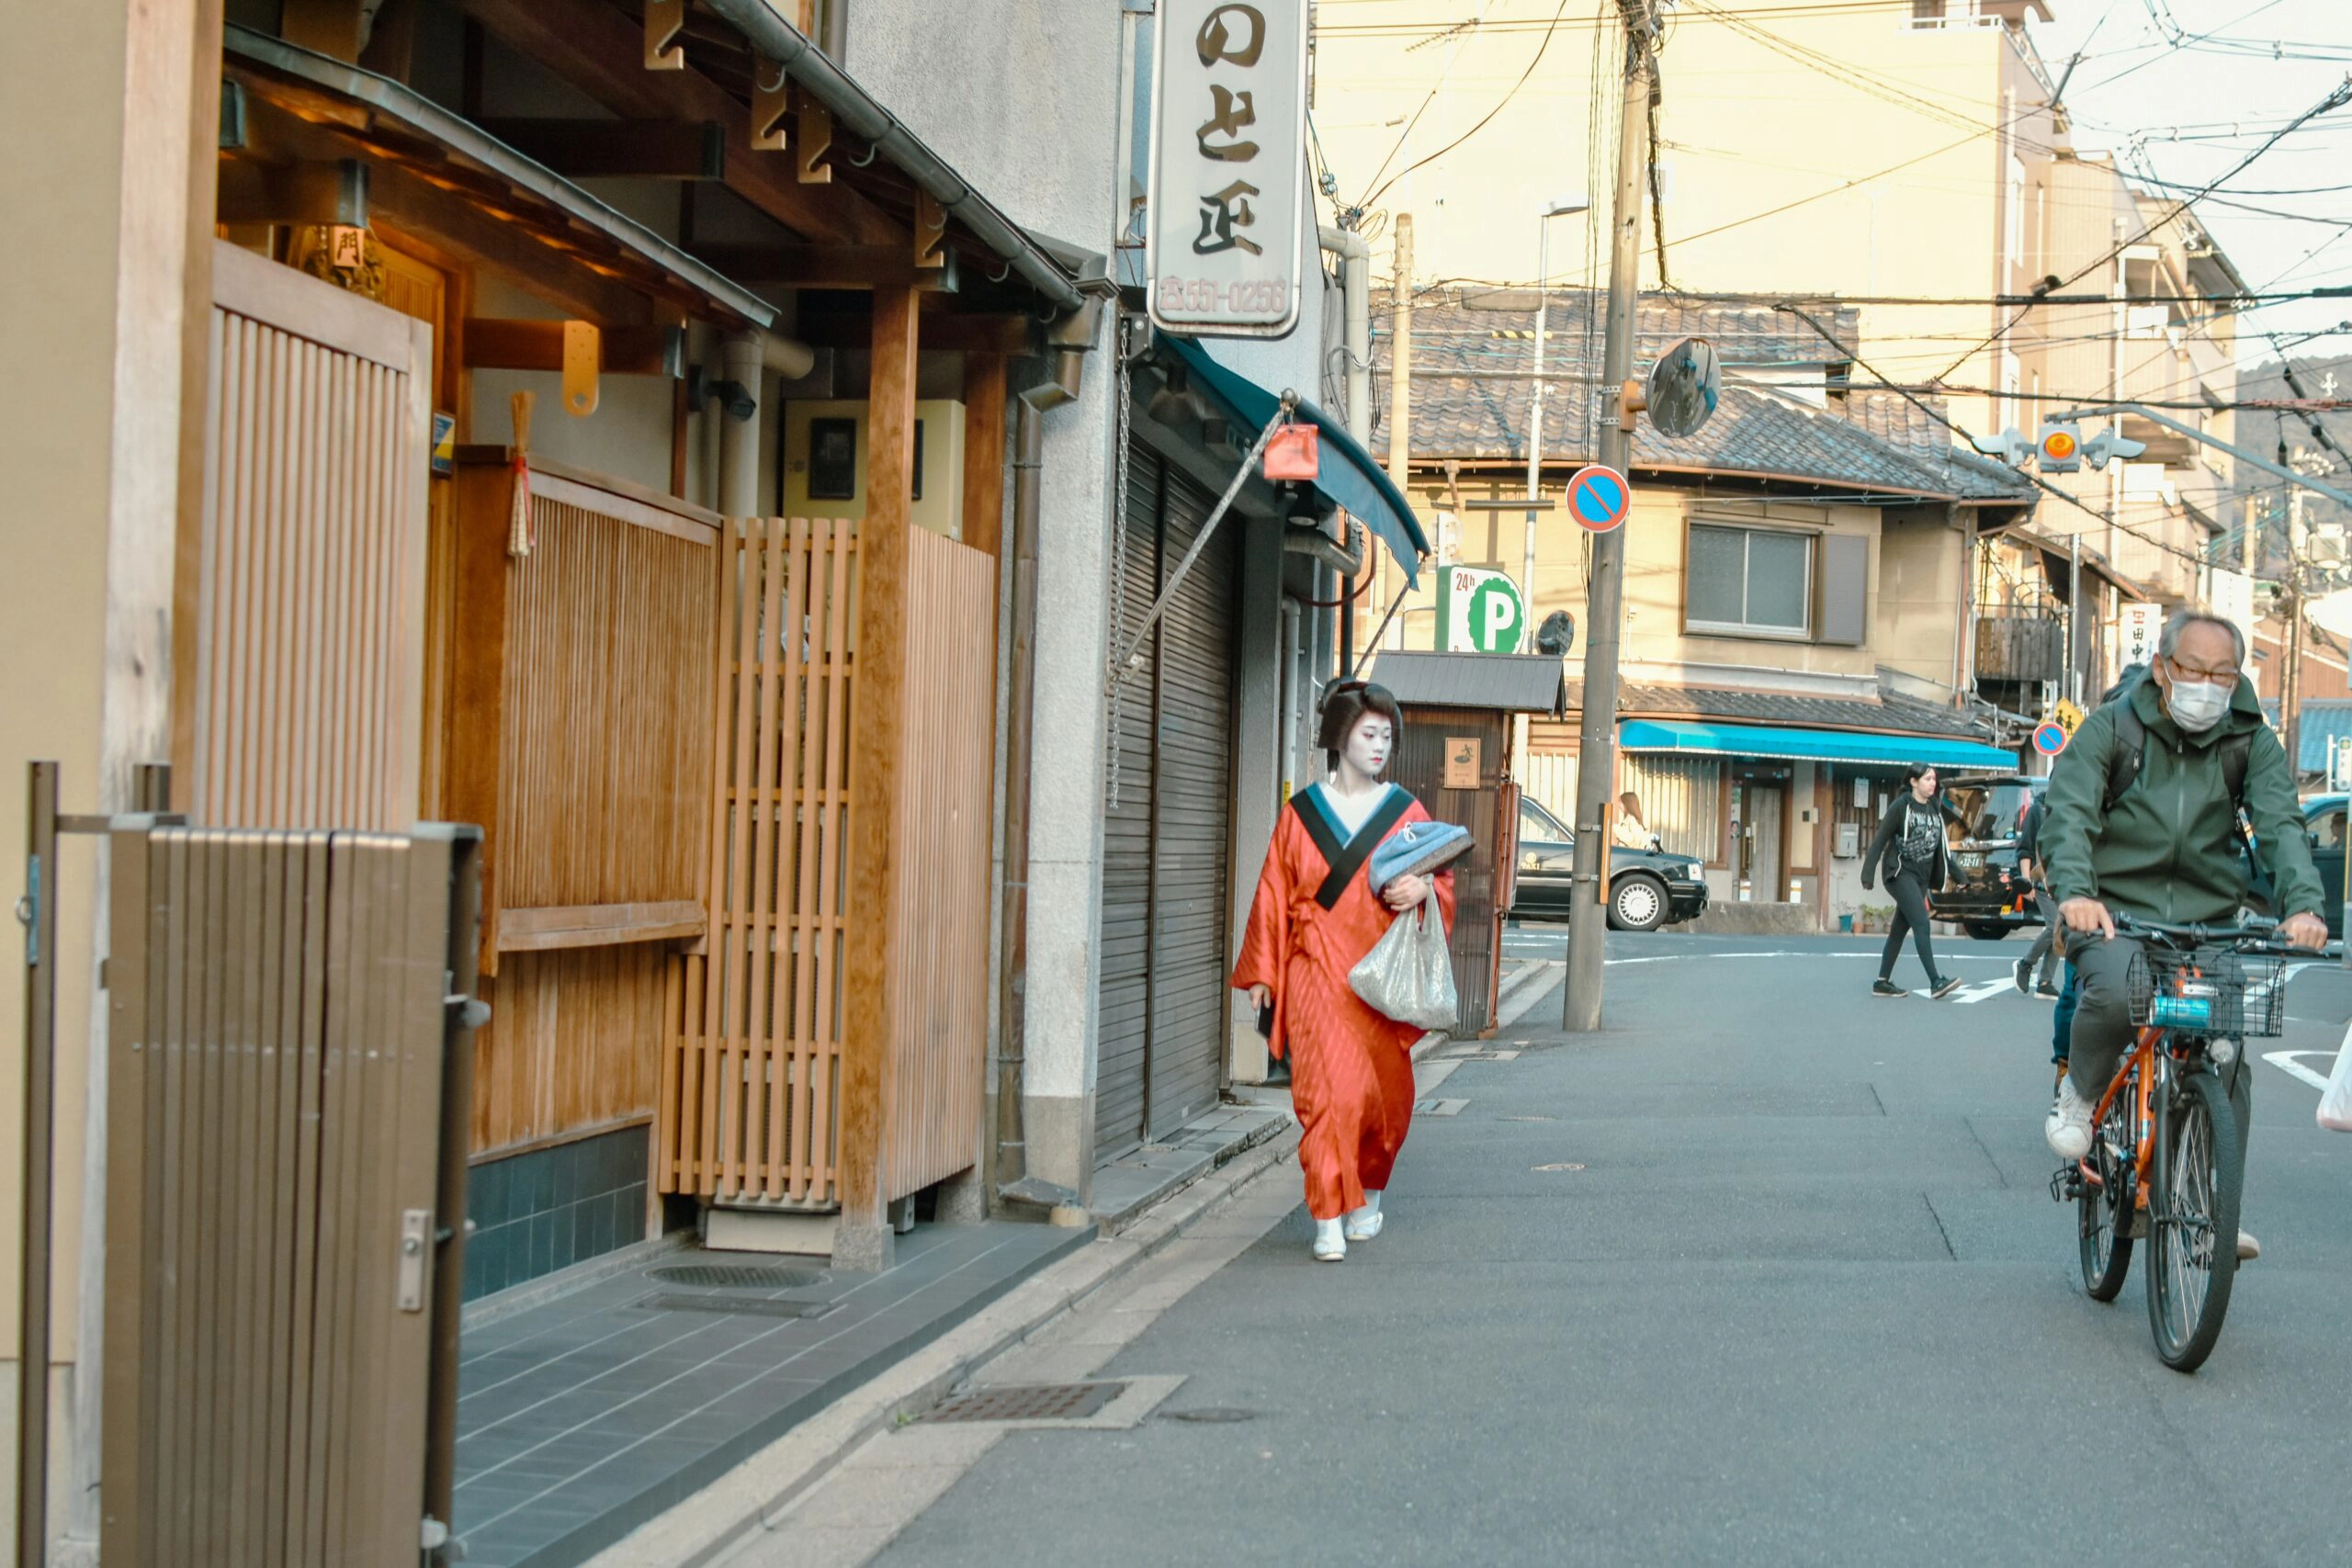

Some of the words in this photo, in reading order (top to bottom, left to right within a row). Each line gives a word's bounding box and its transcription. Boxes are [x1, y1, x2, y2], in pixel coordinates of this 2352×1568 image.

[1185, 278, 1286, 313] 551-0256
[1455, 571, 1476, 592] 24h
[1483, 590, 1515, 650] P
[1521, 862, 1541, 870] TAXI
